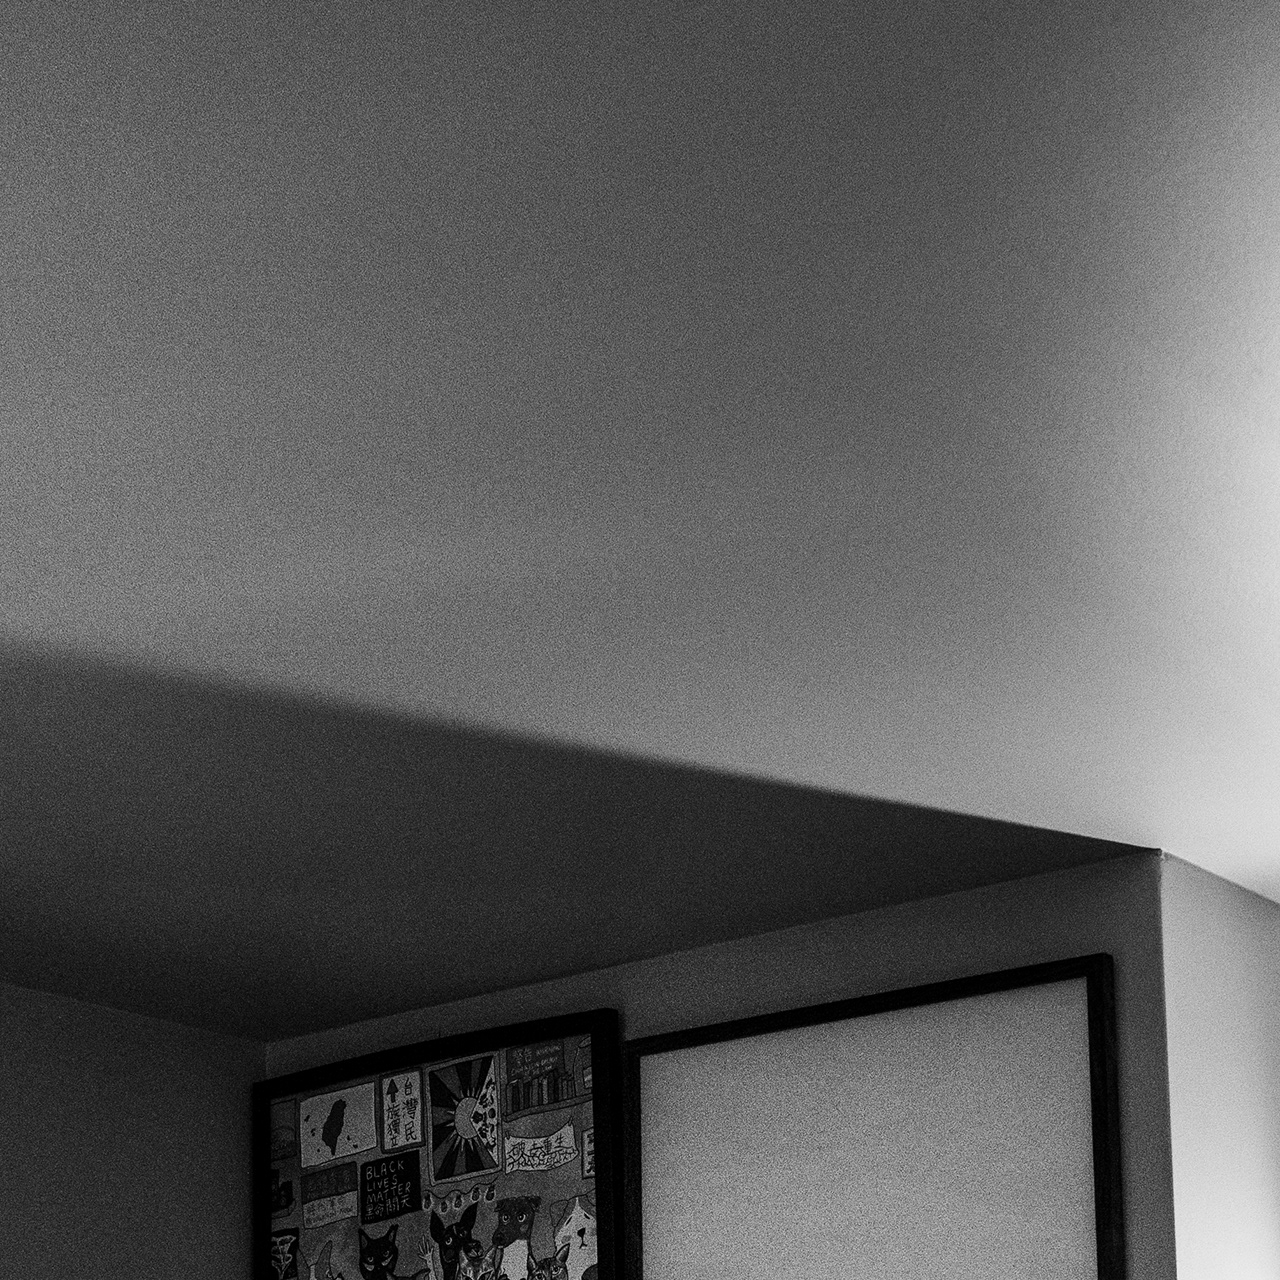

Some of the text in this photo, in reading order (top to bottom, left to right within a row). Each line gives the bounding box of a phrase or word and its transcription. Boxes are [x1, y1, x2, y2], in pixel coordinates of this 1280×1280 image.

[365, 1160, 405, 1181] BLACK
[366, 1174, 398, 1192] LIVES
[366, 1181, 412, 1204] MATTER
